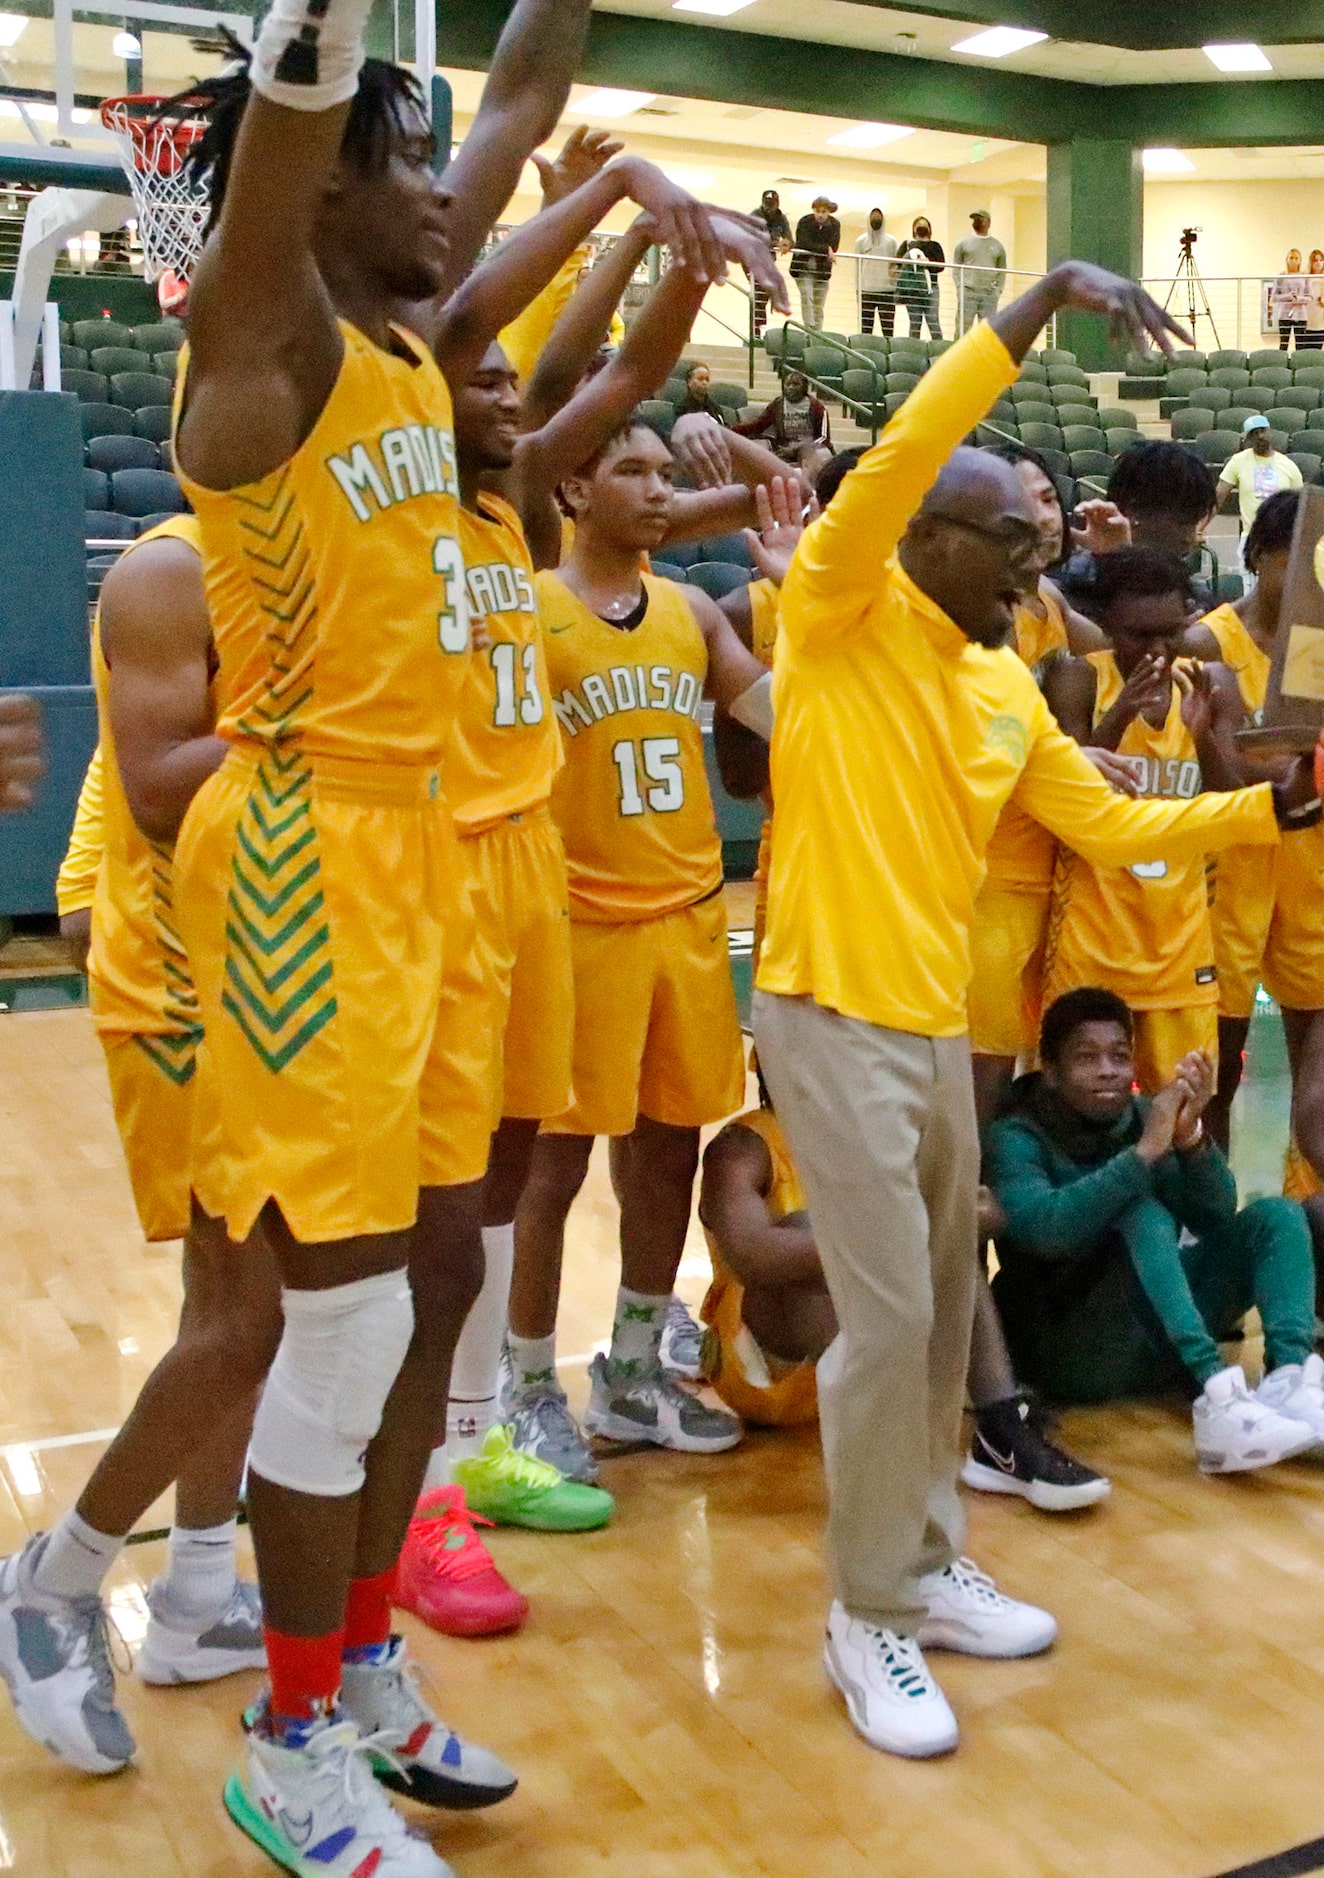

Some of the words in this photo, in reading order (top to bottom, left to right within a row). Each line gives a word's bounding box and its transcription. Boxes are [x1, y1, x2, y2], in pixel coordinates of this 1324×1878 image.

[431, 535, 470, 655] 3
[490, 641, 543, 727] 13
[611, 737, 685, 818] 15
